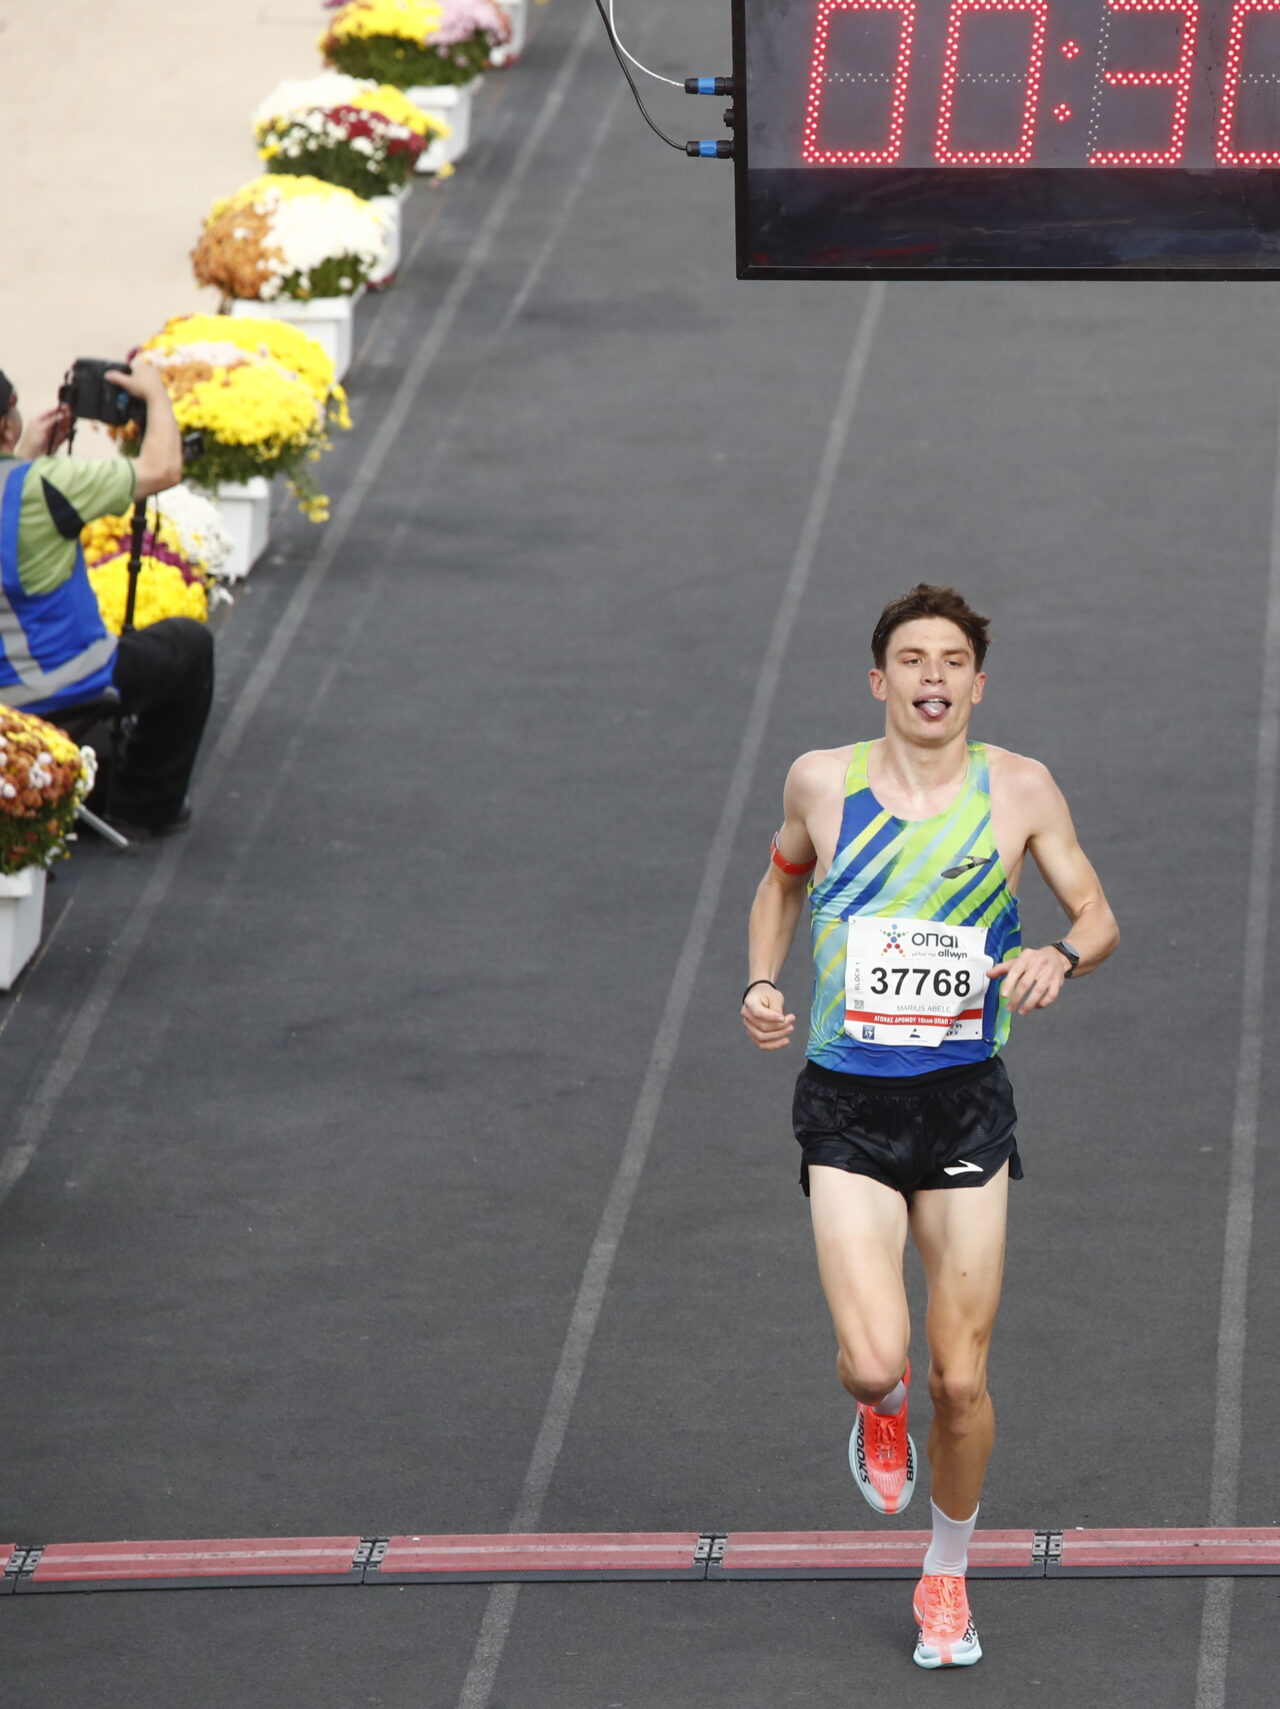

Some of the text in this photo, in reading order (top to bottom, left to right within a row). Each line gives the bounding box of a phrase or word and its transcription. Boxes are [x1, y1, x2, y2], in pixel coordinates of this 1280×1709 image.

[938, 948, 968, 960] allwyn
[870, 967, 971, 997] 37768
[896, 1004, 926, 1012] MARIUS
